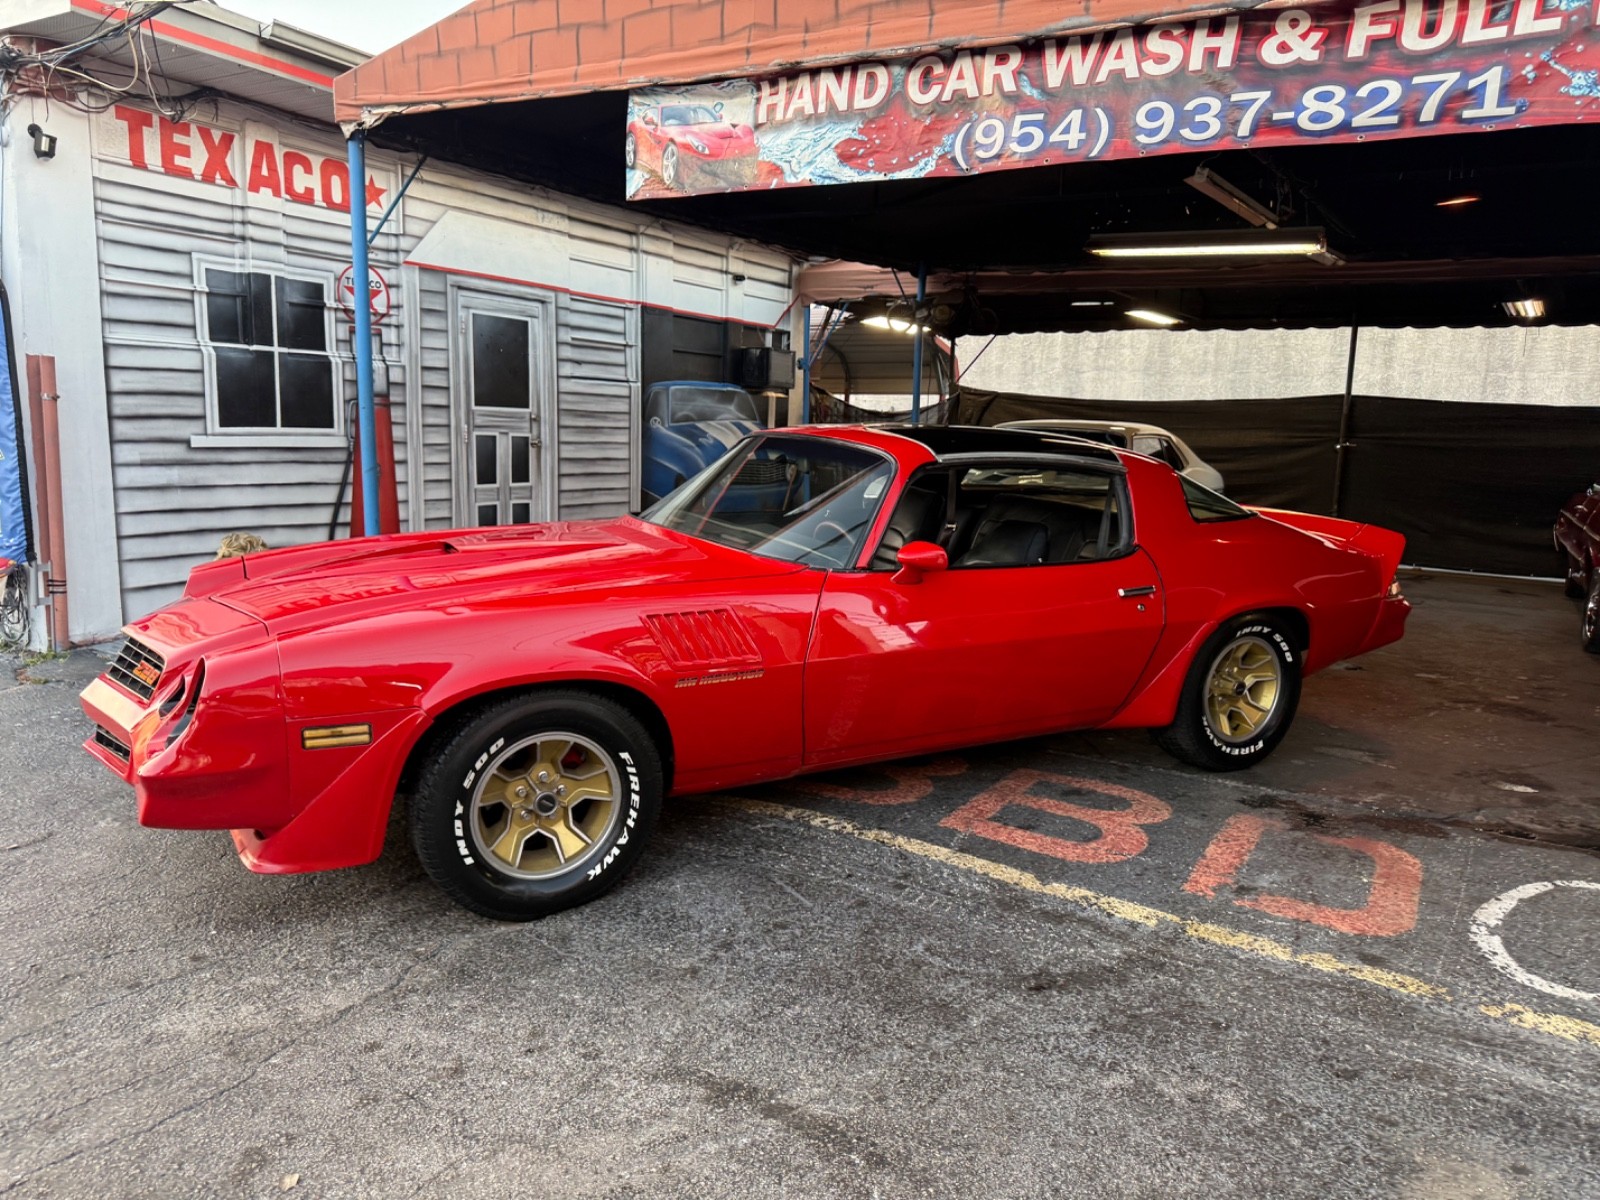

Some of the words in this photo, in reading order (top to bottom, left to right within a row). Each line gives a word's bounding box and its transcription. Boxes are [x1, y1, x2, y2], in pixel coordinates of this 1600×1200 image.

[757, 63, 889, 123] HAND
[906, 46, 1020, 104] CAR
[1043, 16, 1239, 88] WASH
[1261, 9, 1323, 65] &
[1347, 0, 1562, 58] FULL
[954, 108, 1109, 171] (954)
[1135, 65, 1517, 144] 937-8271
[114, 104, 350, 213] TEXACO
[345, 276, 382, 289] TCO
[1236, 625, 1272, 638] INDY
[1273, 633, 1293, 662] 500
[463, 737, 505, 790] 500
[1202, 715, 1264, 755] FIREHAWK
[454, 800, 475, 866] INDY
[586, 752, 640, 881] FIREHAWK
